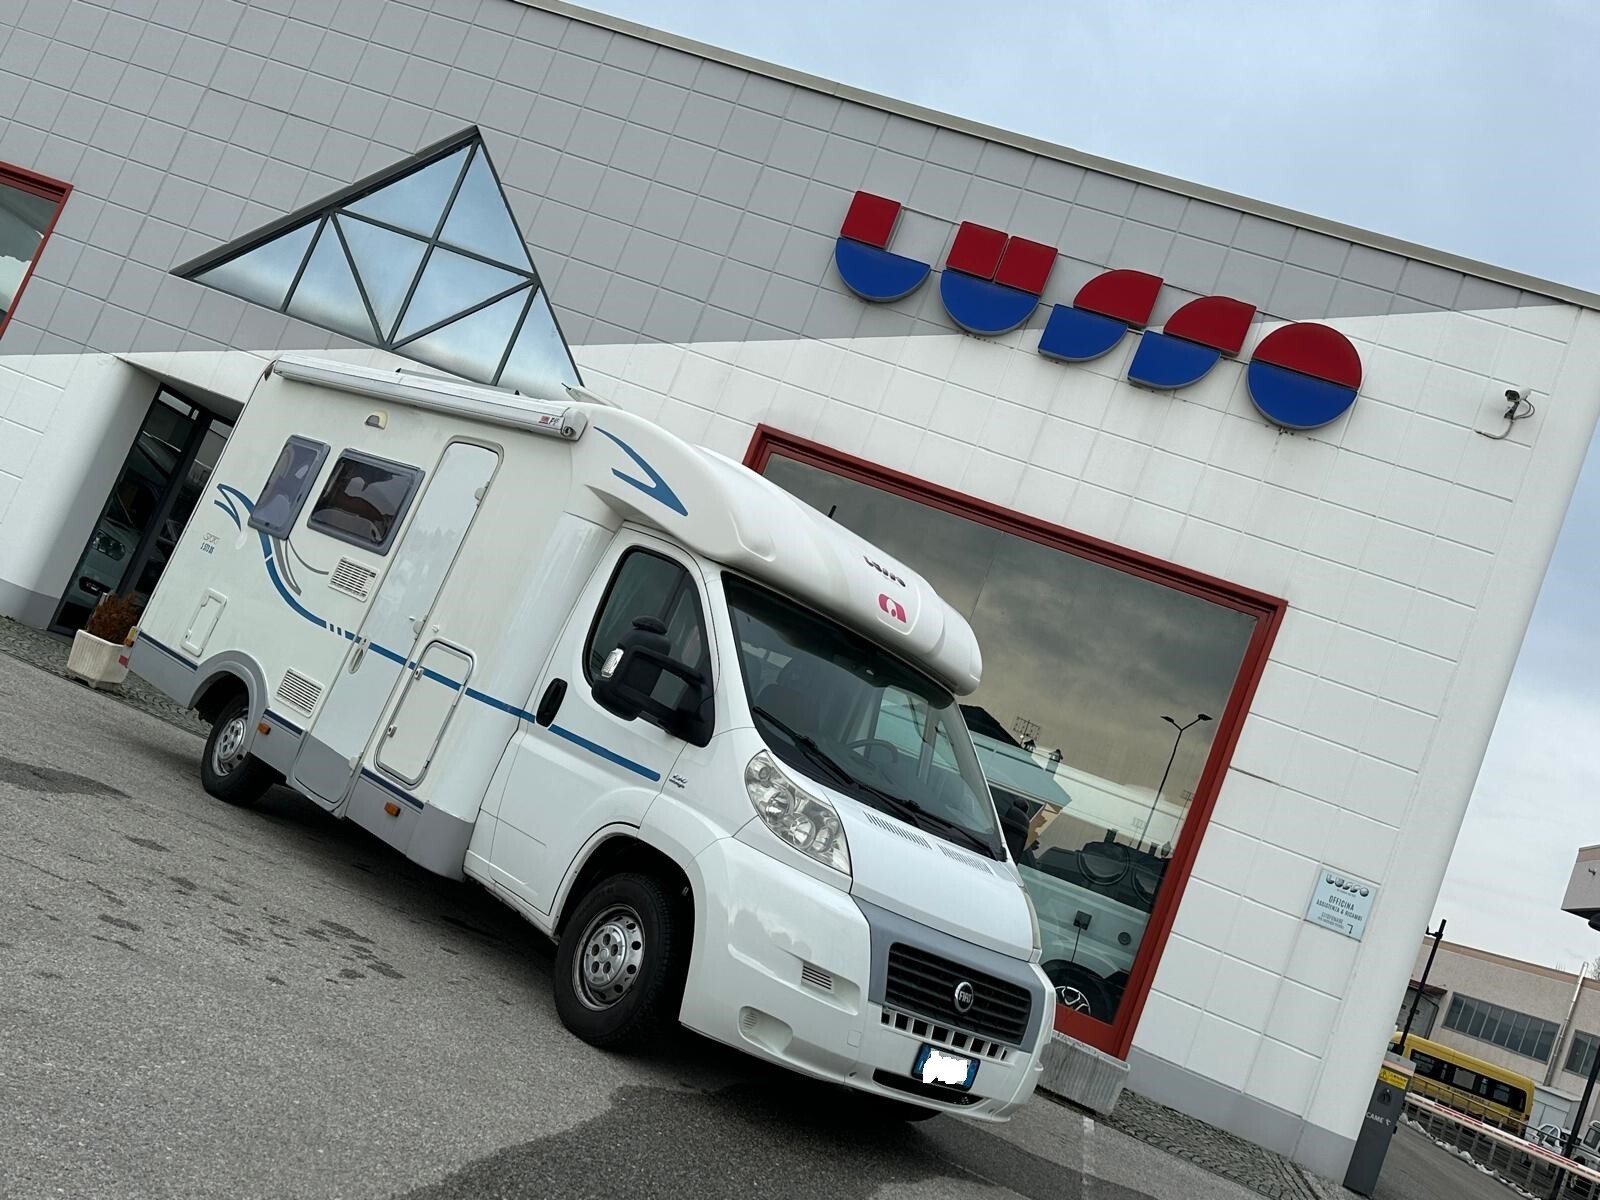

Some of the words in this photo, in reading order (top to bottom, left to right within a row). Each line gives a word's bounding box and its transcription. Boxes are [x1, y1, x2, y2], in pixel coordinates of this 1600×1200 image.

[1326, 874, 1369, 897] LUSSO
[1328, 895, 1355, 911] OFFICINA
[958, 990, 972, 1003] FIAT
[1366, 1111, 1385, 1124] CAME
